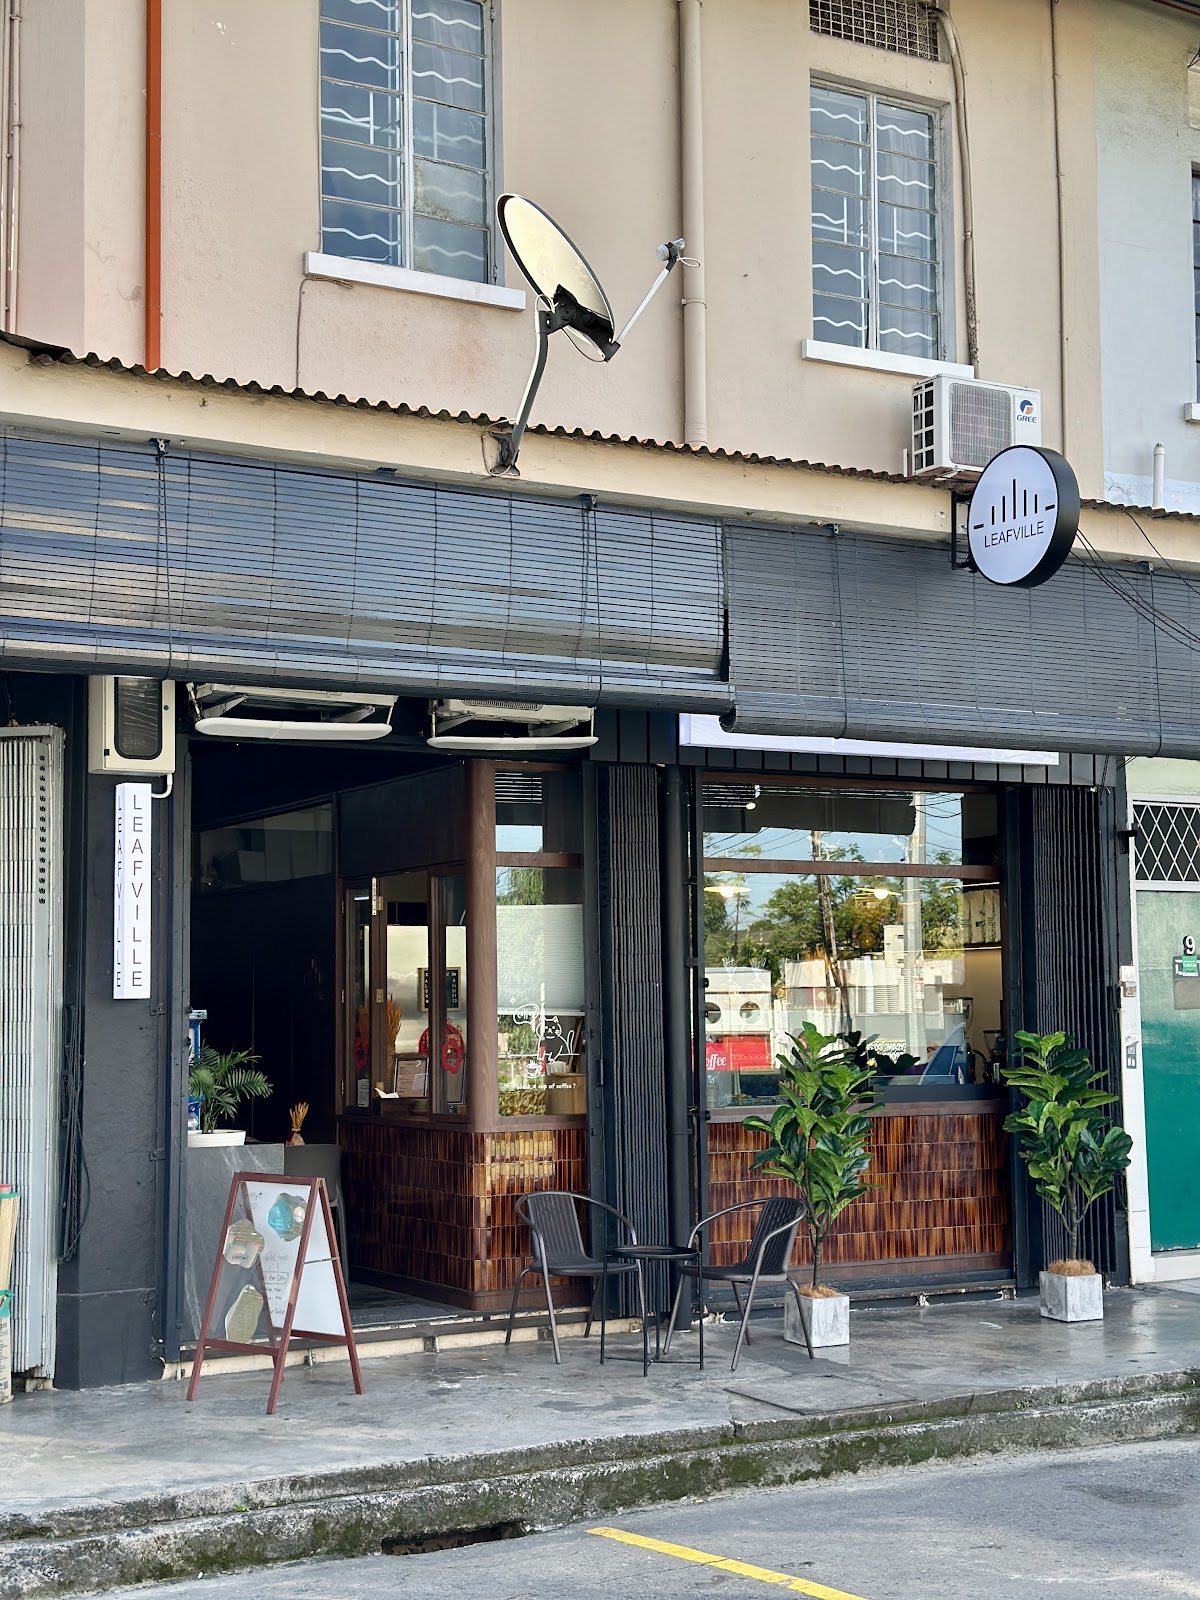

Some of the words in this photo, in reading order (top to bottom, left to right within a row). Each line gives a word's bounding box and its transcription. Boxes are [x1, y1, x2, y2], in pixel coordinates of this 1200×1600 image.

[1016, 414, 1037, 424] GREE
[984, 520, 1044, 548] LEAFVILLE
[131, 794, 143, 987] LEAFVILLE
[1184, 935, 1195, 955] 9
[706, 1053, 727, 1071] offee
